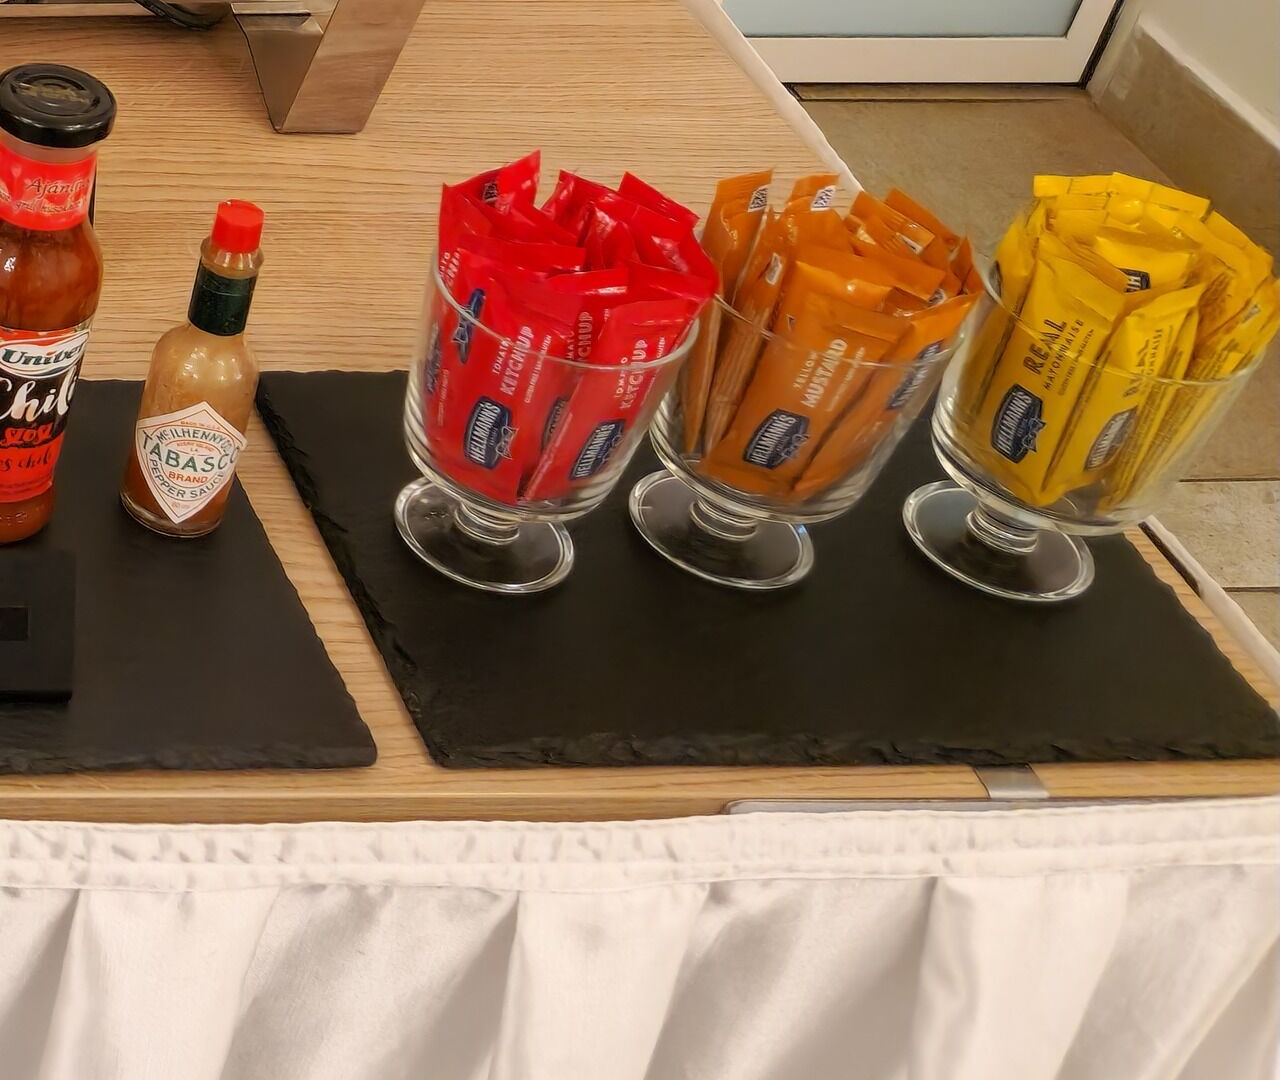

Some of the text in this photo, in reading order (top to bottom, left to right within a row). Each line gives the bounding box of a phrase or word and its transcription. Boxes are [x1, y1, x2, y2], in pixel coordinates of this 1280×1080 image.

[800, 338, 849, 409] MUSTARD
[1022, 319, 1068, 376] REAL
[469, 401, 501, 464] HELLMANN'S
[750, 414, 796, 465] HELLMANN'S
[997, 391, 1033, 455] HELLMANN'S
[149, 458, 187, 499] PEPPER
[168, 470, 209, 484] BRAND
